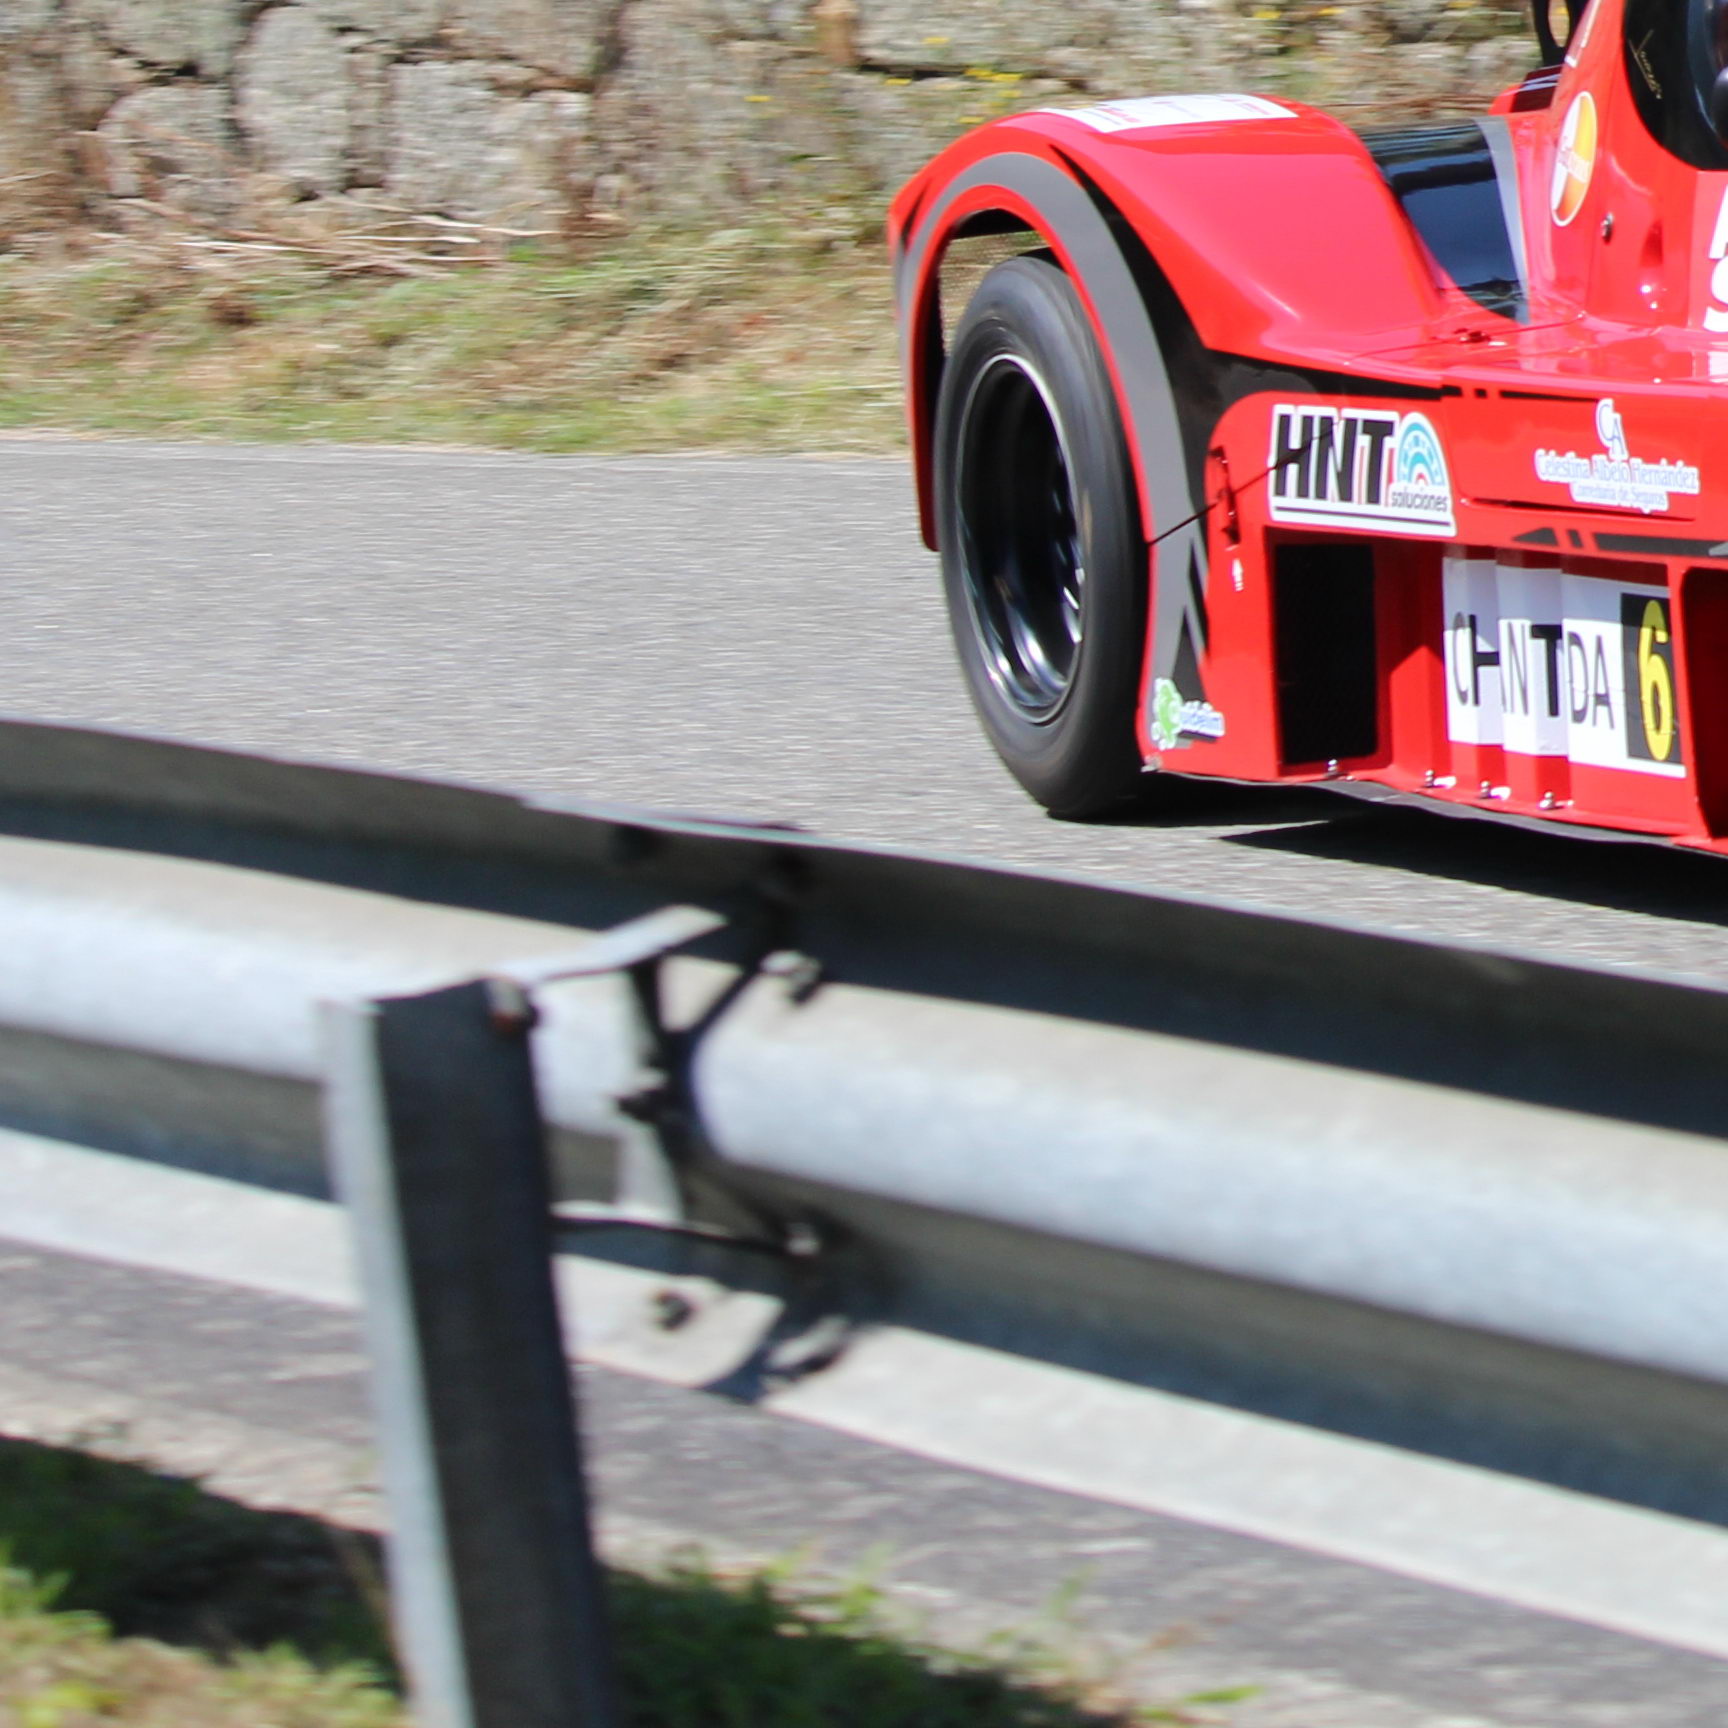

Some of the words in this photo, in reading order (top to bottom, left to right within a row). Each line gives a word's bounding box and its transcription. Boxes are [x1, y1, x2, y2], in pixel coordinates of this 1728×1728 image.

[1274, 412, 1395, 505] HNT
[1391, 486, 1448, 513] soluciones
[1639, 600, 1674, 762] 6
